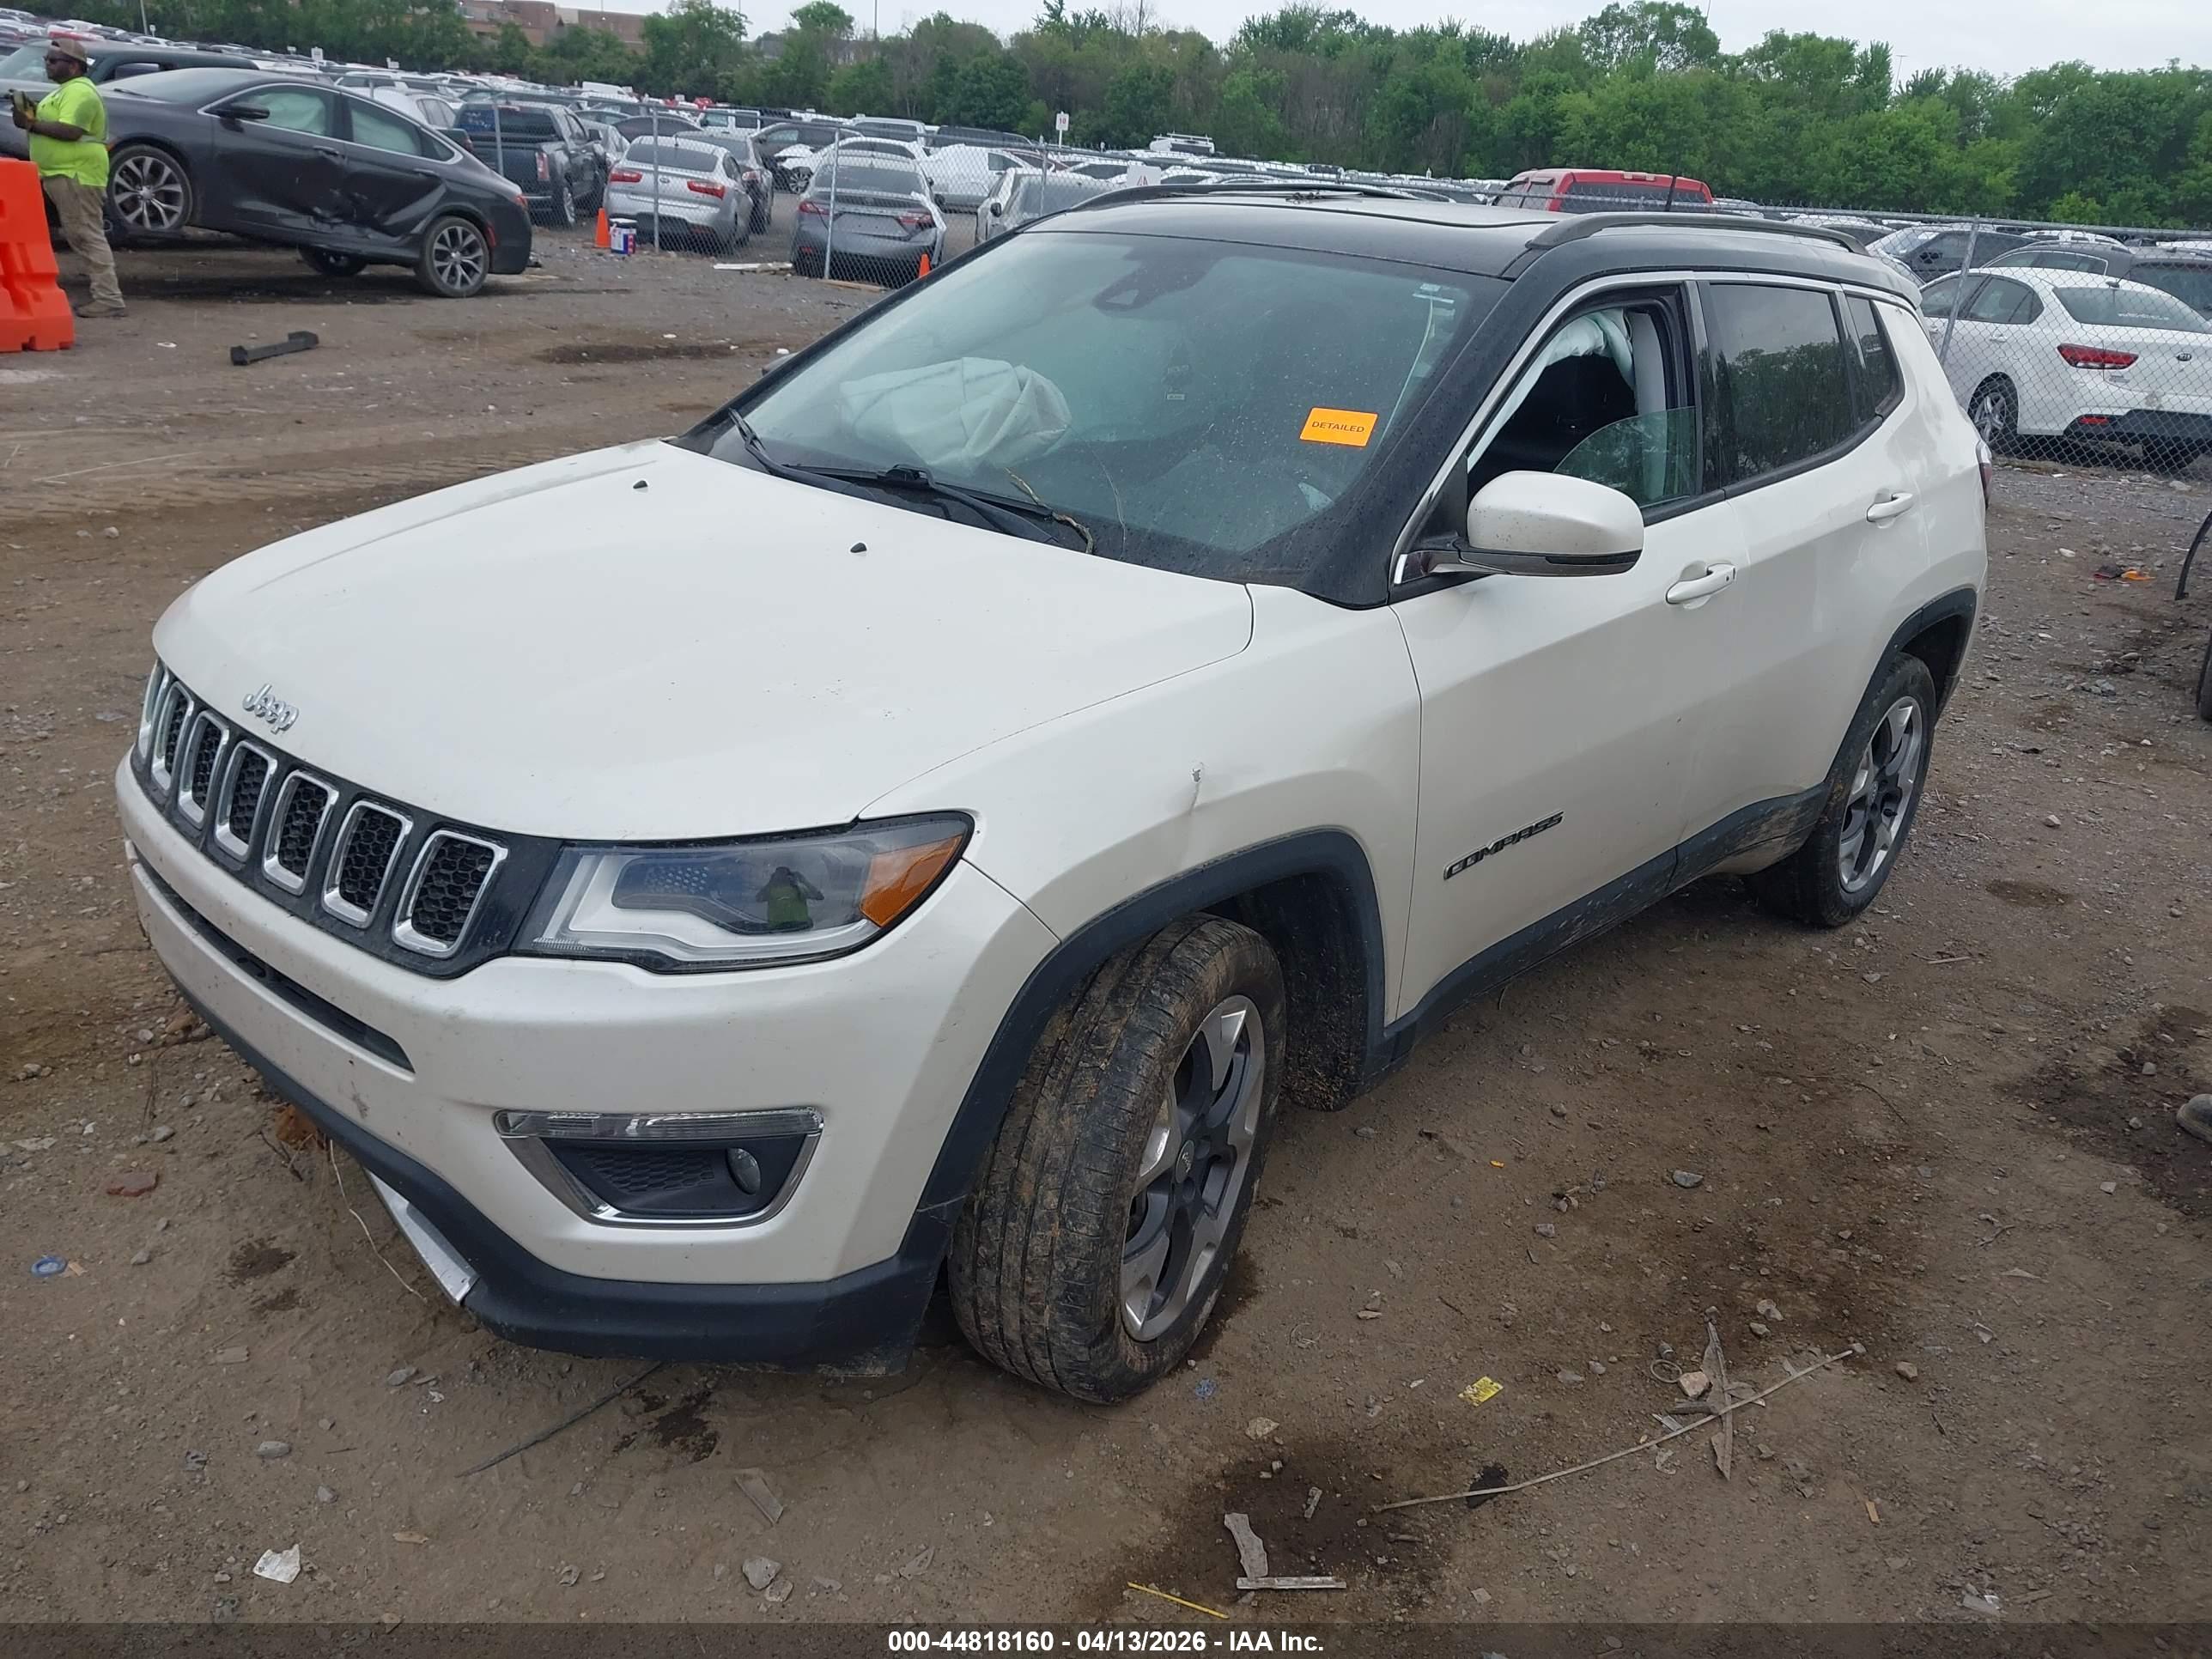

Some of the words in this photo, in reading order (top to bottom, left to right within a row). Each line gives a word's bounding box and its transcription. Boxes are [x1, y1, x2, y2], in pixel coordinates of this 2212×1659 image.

[1311, 421, 1365, 433] DETAILED
[242, 684, 300, 735] Jeep
[1443, 811, 1565, 880] COMPASS
